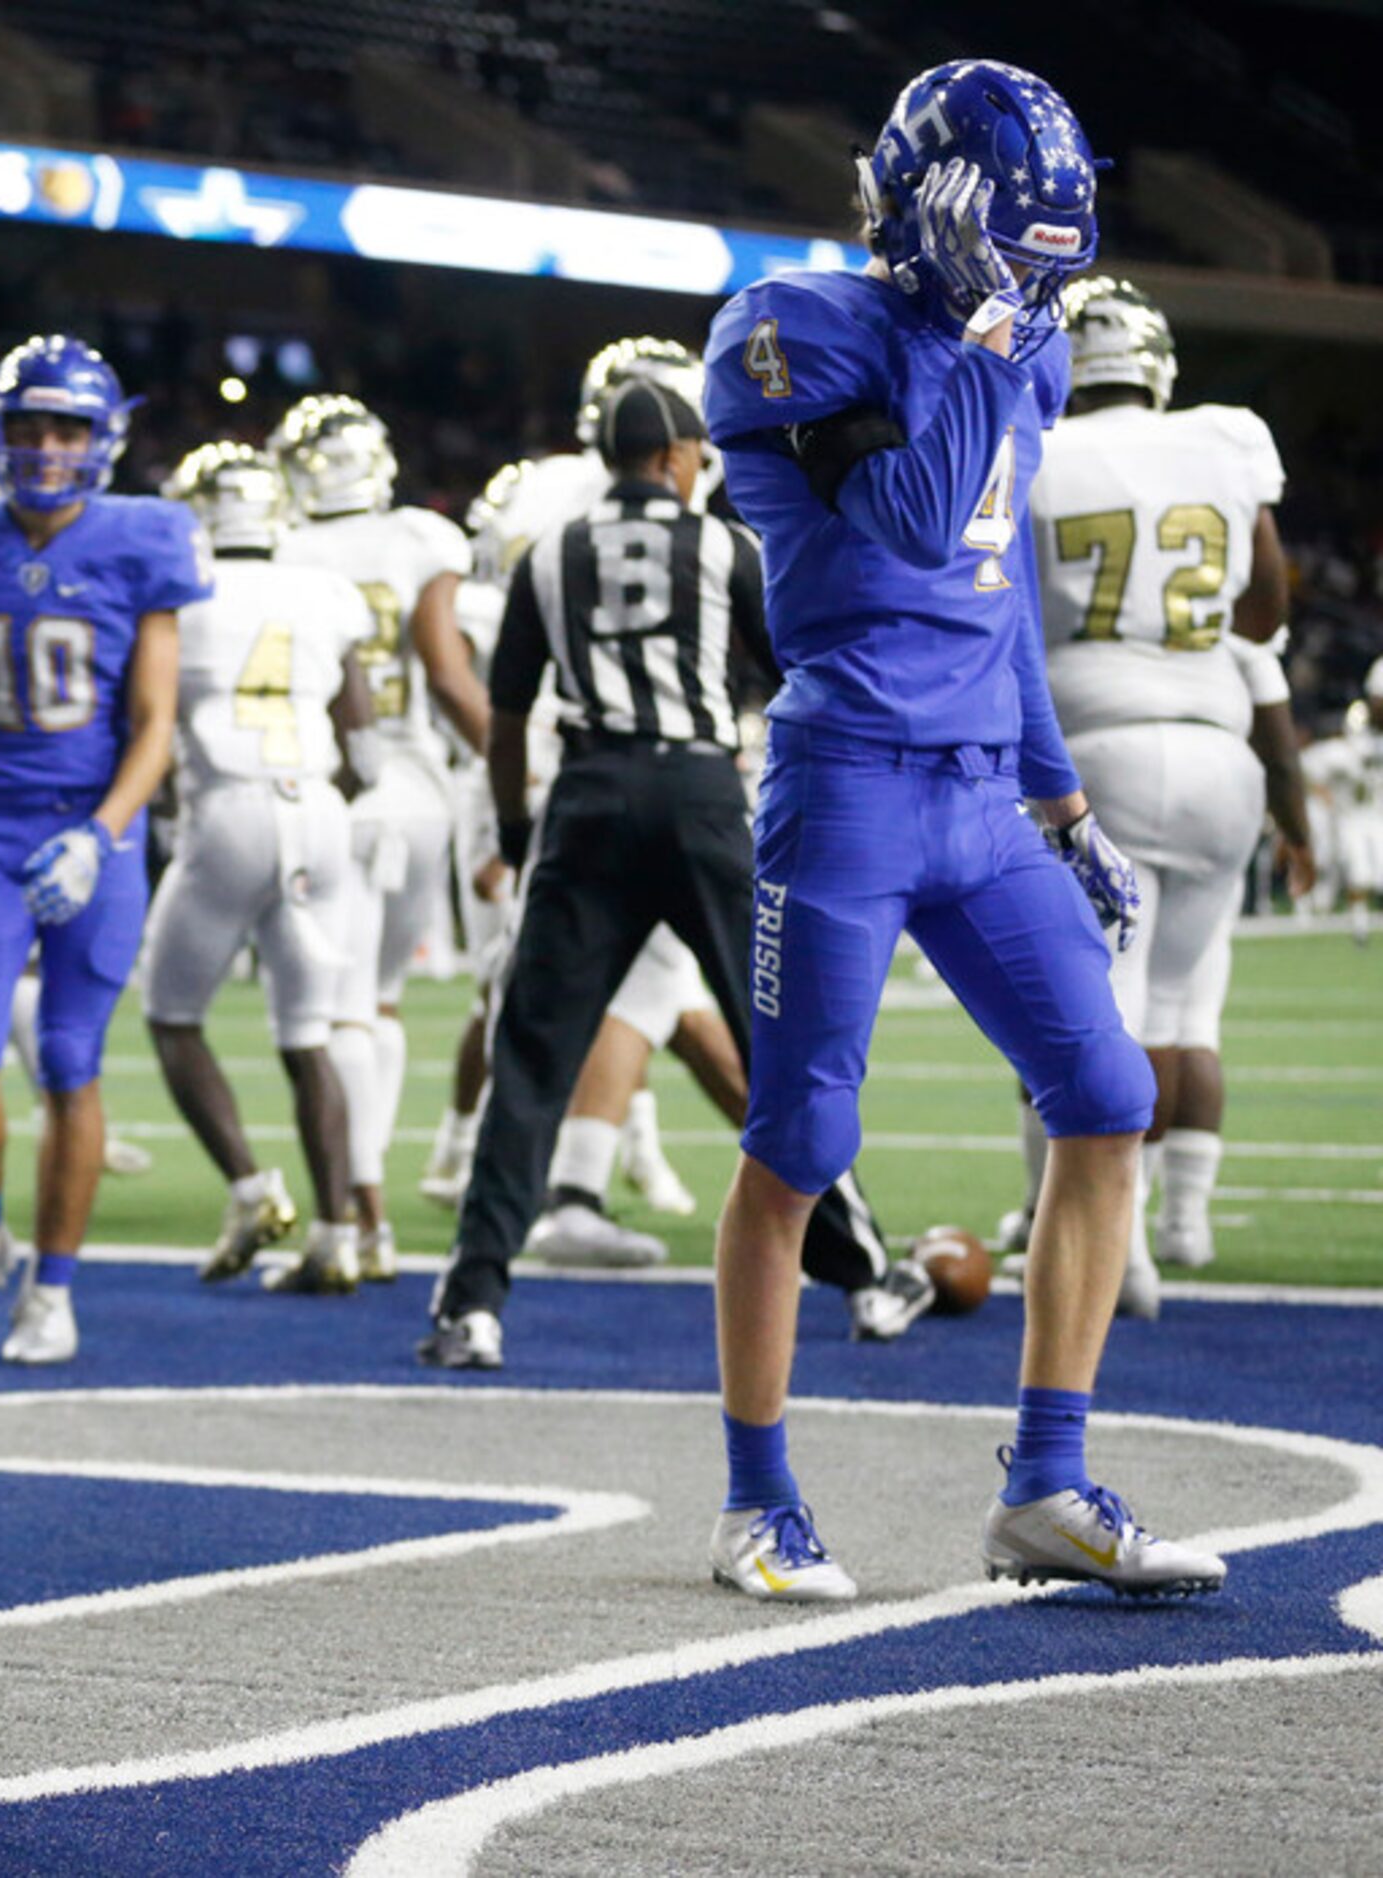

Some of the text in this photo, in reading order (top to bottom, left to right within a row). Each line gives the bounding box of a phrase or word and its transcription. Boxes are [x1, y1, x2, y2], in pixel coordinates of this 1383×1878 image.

[744, 319, 791, 398] 4
[591, 520, 672, 635] B
[962, 426, 1016, 591] 4
[1055, 505, 1228, 649] 72
[234, 622, 301, 766] 4
[752, 879, 787, 1019] FRISCO
